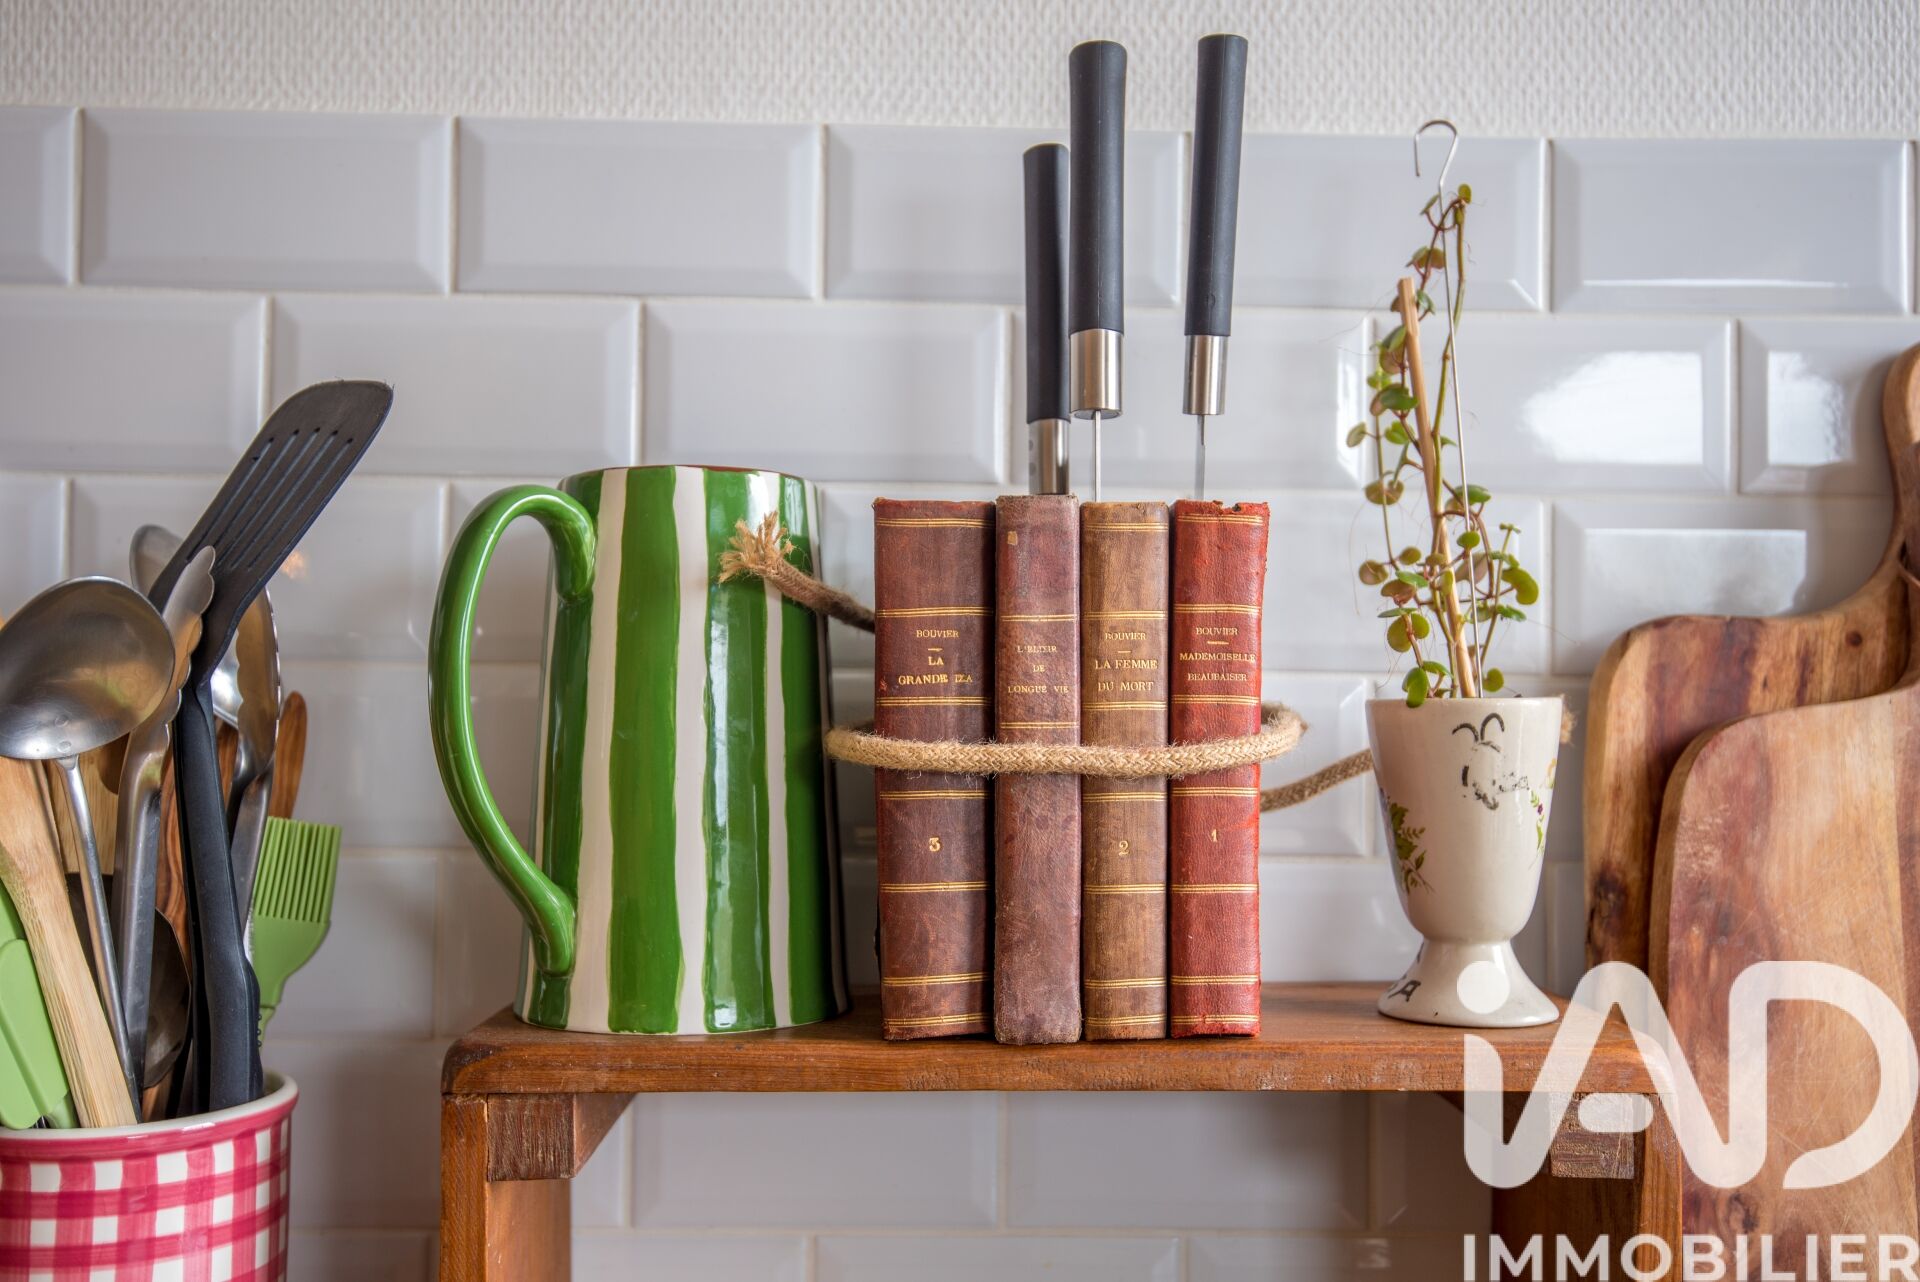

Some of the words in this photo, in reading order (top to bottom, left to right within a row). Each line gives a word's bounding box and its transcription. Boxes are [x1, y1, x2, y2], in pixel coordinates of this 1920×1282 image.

[916, 629, 959, 638] BOUVIER
[1105, 632, 1146, 640] BOUVIER
[1196, 627, 1238, 636] BOUVIER
[928, 656, 944, 666] LA
[1180, 652, 1256, 662] MADEMOISELLE
[1033, 664, 1045, 672] DE
[1095, 660, 1111, 670] LA
[1115, 659, 1158, 670] FEMME
[898, 674, 949, 685] GRANDE
[1187, 673, 1247, 681] BEAUBAISER
[1007, 685, 1048, 694] LONGUE
[1054, 685, 1069, 694] VIE
[1098, 682, 1114, 692] DU
[1120, 681, 1154, 691] MORT
[1211, 829, 1218, 842] 1
[929, 837, 941, 852] 3
[1119, 840, 1129, 856] 2
